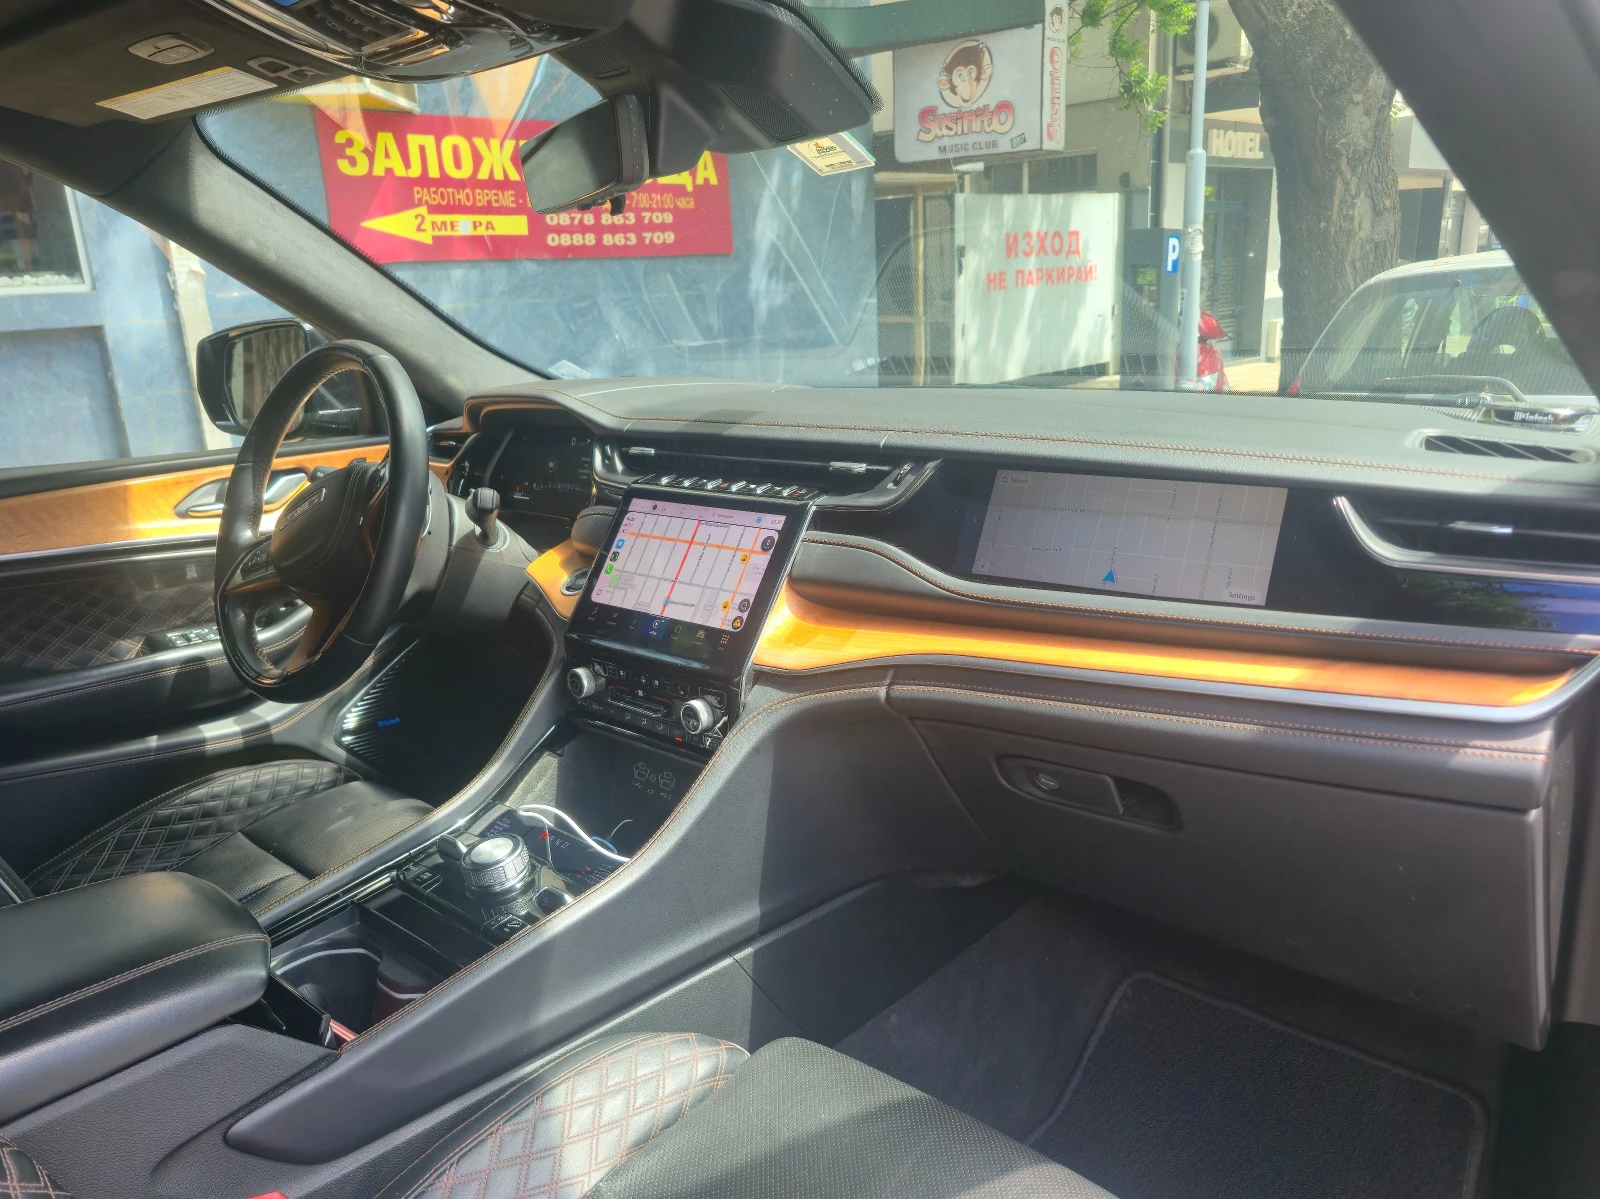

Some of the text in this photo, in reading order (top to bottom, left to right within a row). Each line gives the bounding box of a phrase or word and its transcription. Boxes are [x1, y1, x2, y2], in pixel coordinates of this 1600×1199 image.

[938, 140, 998, 154] MUSIC CLUB
[1207, 128, 1265, 159] HOTEL
[334, 129, 528, 181] ЗАЛОЖ
[413, 186, 473, 206] РАБОТНО
[476, 189, 517, 207] ВРЕМЕ
[414, 213, 496, 233] 2 МЕРА
[545, 211, 674, 226] 0878 863 709
[546, 231, 675, 246] 0888 863 709
[1005, 230, 1081, 261] ИЗХОД
[1166, 237, 1180, 272] P
[986, 260, 1098, 291] НЕ ПАРКИРАЙ!
[1513, 411, 1555, 424] McIntosh
[1228, 591, 1256, 602] Settings
